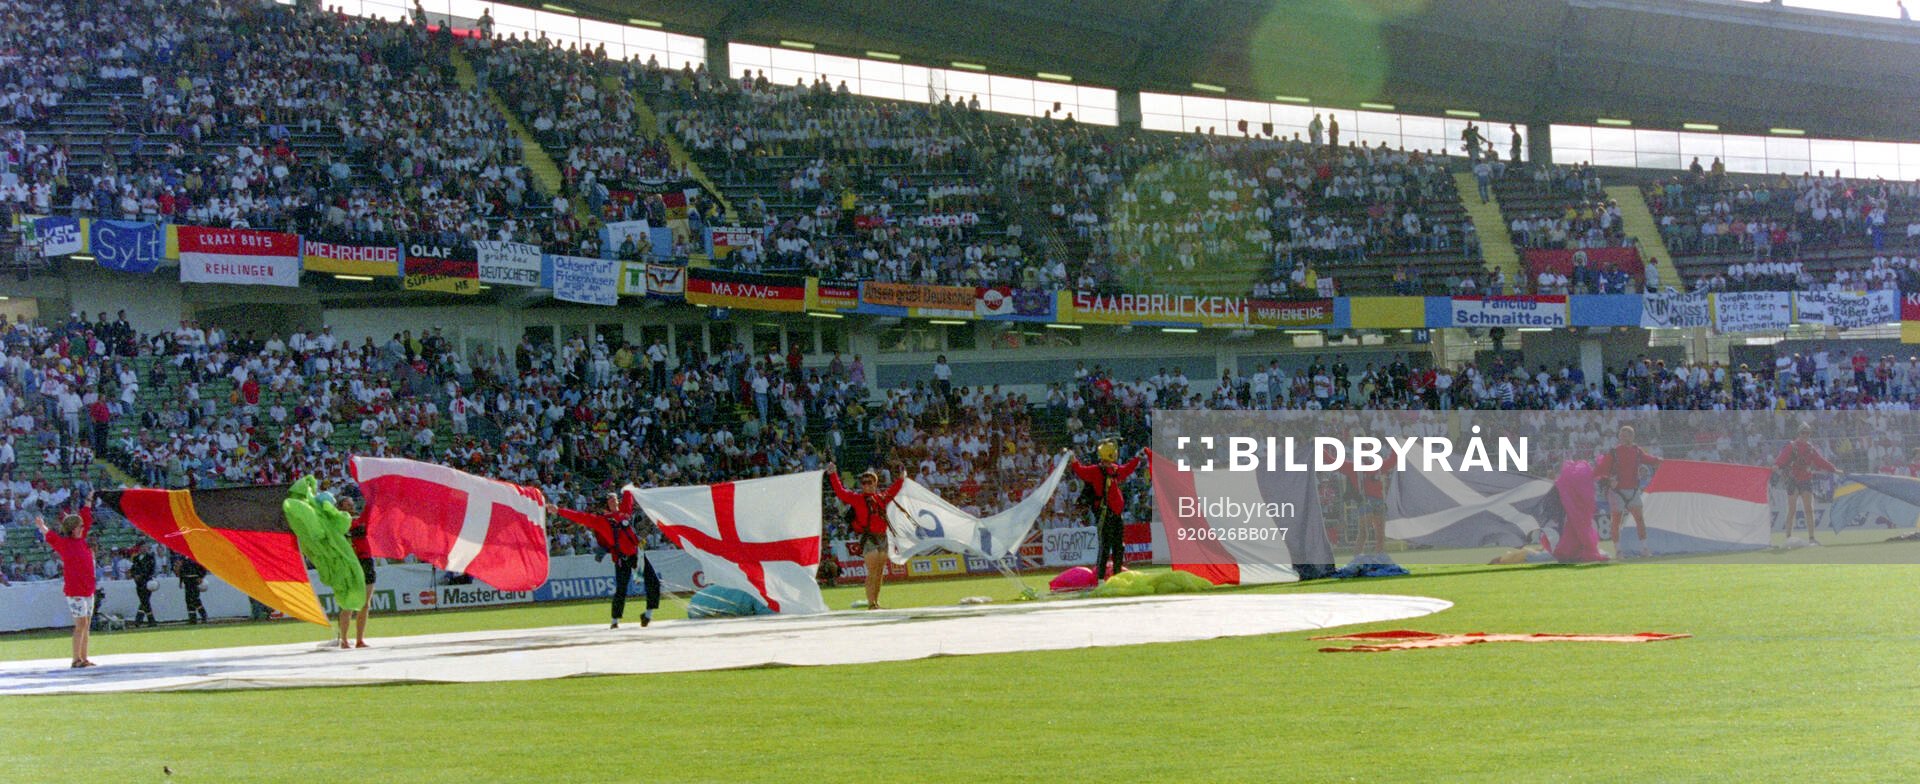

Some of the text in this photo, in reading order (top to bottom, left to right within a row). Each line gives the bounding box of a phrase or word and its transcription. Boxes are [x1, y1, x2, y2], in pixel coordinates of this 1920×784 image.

[199, 234, 273, 248] CRAZY BOYS
[305, 241, 397, 262] MEHRHOOG
[410, 244, 452, 259] OLAF
[205, 263, 274, 276] REHLINGEN
[711, 282, 733, 295] MA
[1456, 310, 1563, 326] Schnaittach
[550, 577, 617, 598] PHILIPS
